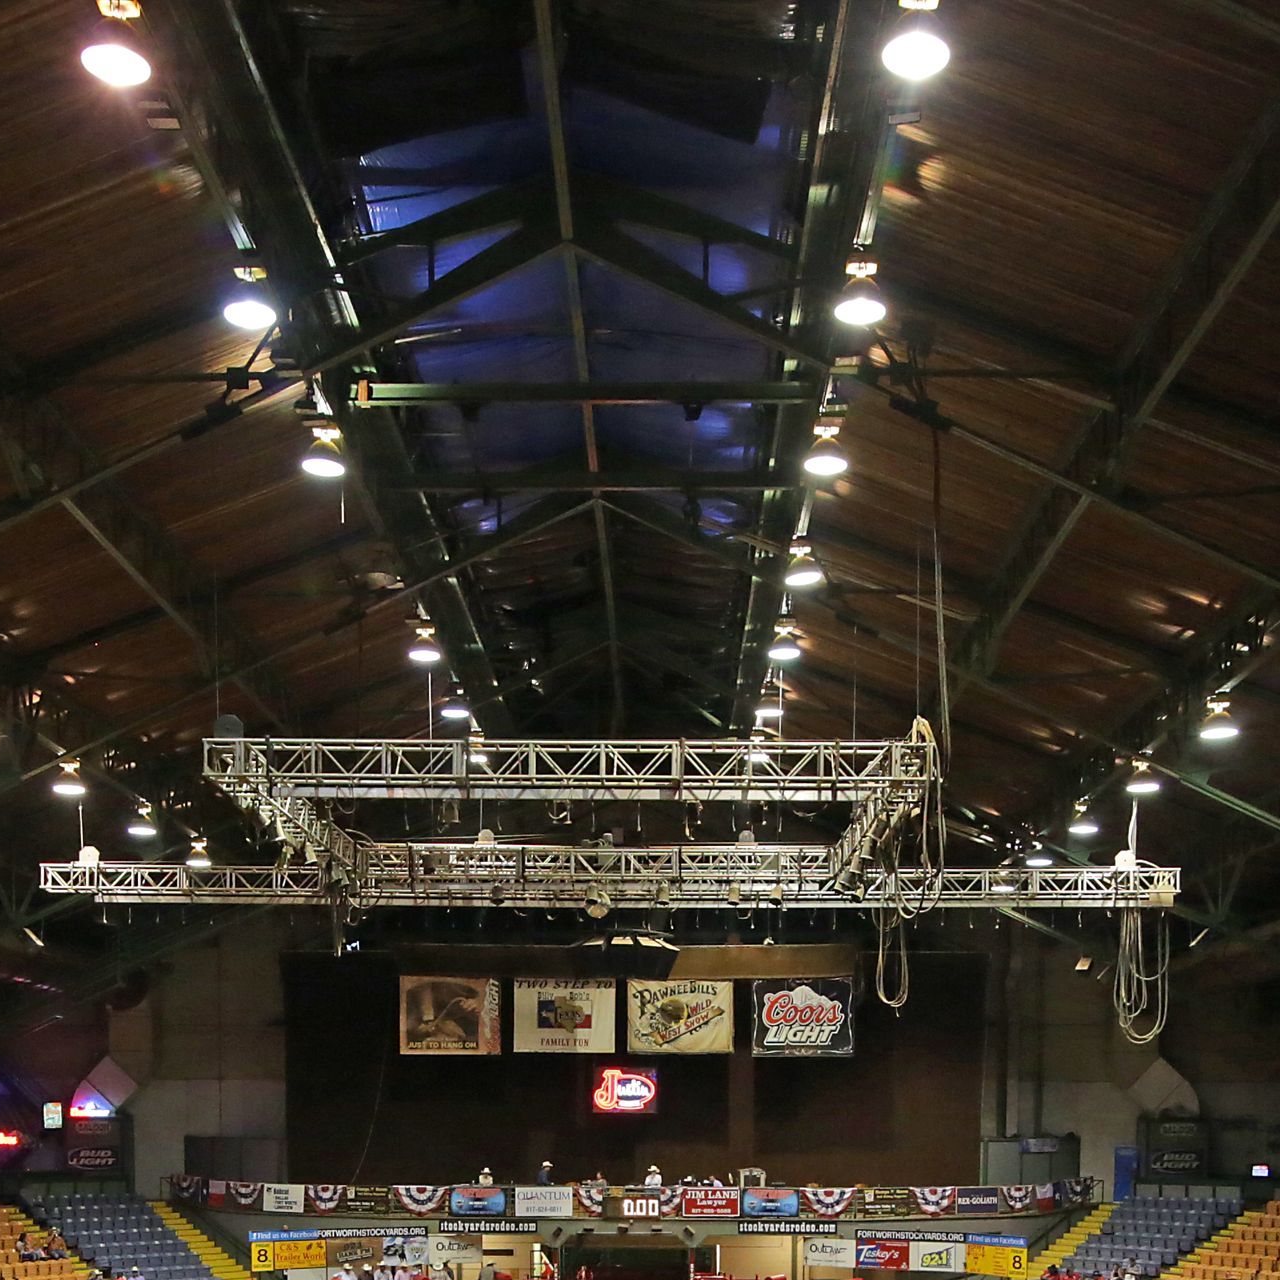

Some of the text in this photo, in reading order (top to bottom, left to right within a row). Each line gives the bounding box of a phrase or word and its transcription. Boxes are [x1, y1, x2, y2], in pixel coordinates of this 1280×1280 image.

[516, 979, 614, 989] TWO STEP TO
[689, 998, 713, 1017] WILD
[764, 992, 844, 1026] Coors
[659, 1011, 710, 1042] WEST SHOW
[764, 1024, 837, 1045] LIGHT
[407, 1041, 477, 1049] JUST TO HANG ON
[540, 1038, 589, 1047] FAMILY FUN
[79, 1149, 113, 1159] BUD
[70, 1156, 117, 1167] LIGHT
[517, 1190, 571, 1200] QUANTUM
[685, 1190, 738, 1199] JIM LANE
[696, 1198, 728, 1206] Lawyer
[957, 1196, 998, 1205] REX-GOLIATH
[440, 1220, 537, 1232] stockyardsrodeo.com
[739, 1221, 836, 1233] stockyardsrodeo.com
[257, 1231, 271, 1240] Find
[290, 1230, 318, 1239] Facebook
[318, 1227, 426, 1238] FORTWORTHSTOCKYARDS.ORG
[857, 1230, 964, 1242] FORTWORTHSTOCKYARDS.ORG
[279, 1243, 300, 1251] C&S
[857, 1244, 900, 1260] Teskey's
[257, 1249, 268, 1264] 8
[275, 1253, 301, 1262] Trailer
[921, 1252, 948, 1267] 92.1
[1012, 1256, 1022, 1270] 8
